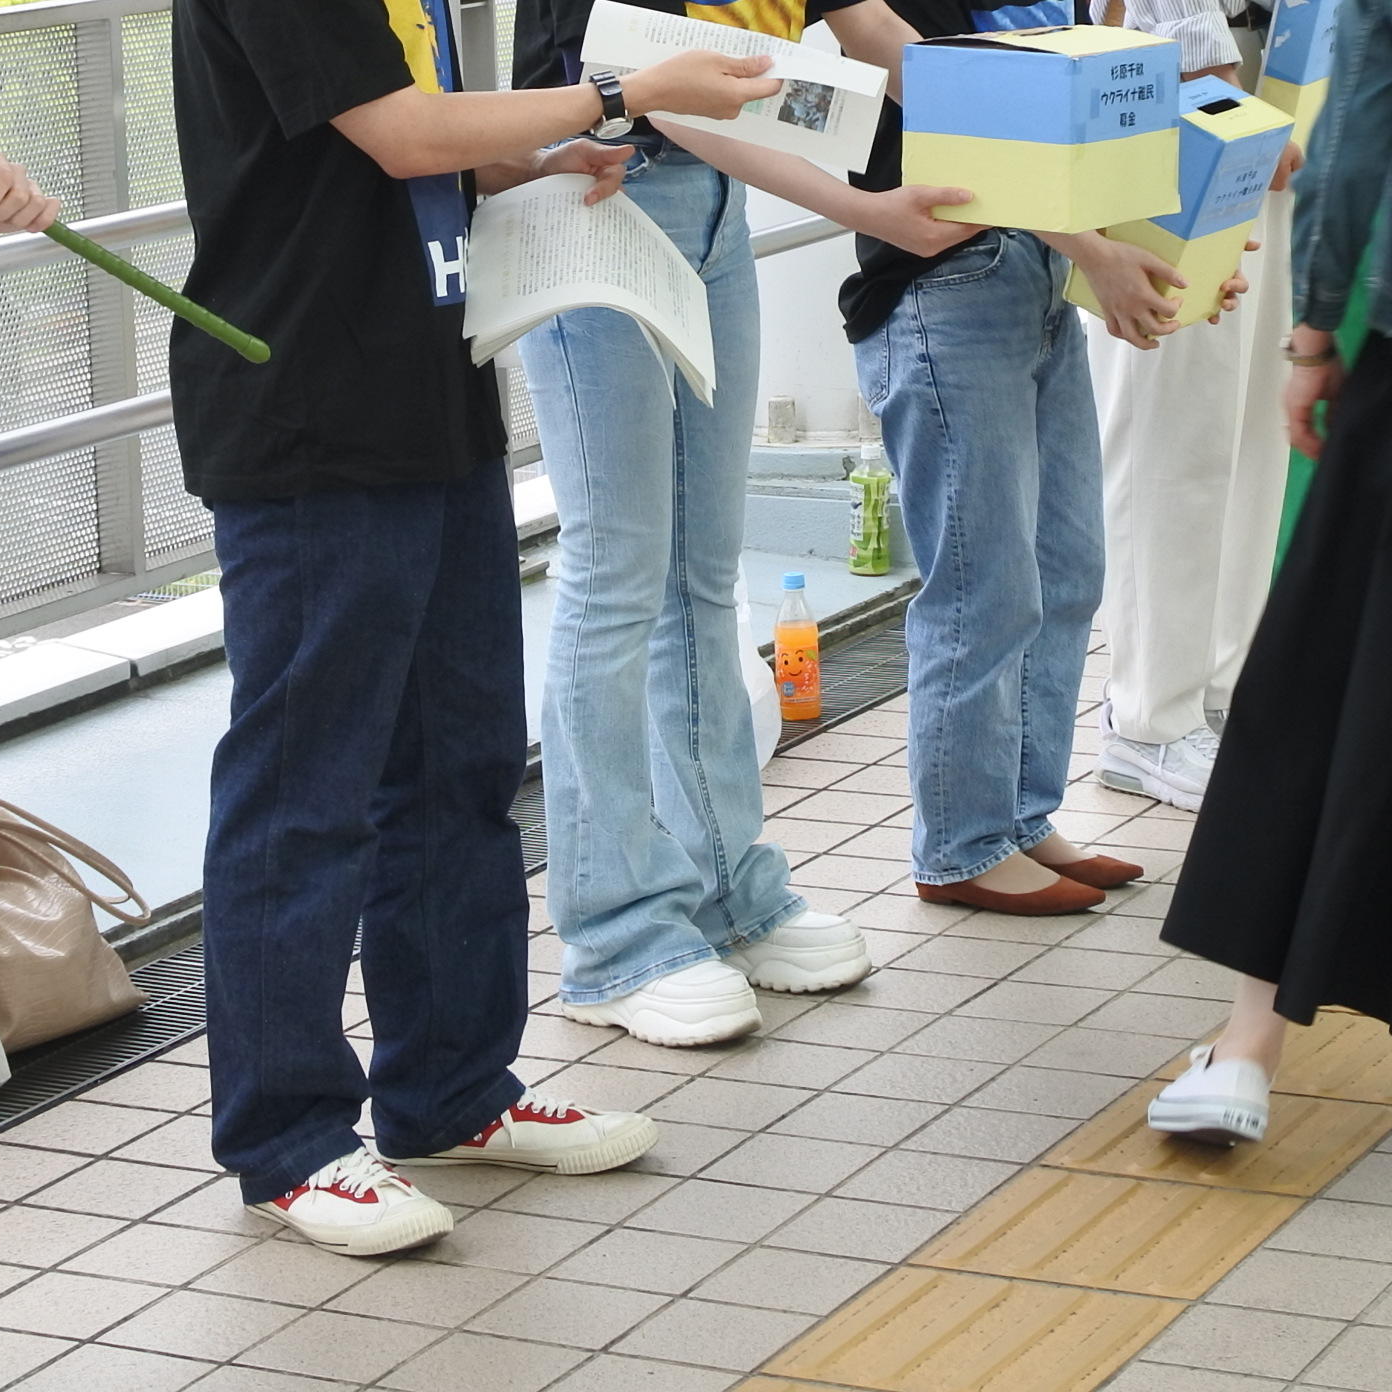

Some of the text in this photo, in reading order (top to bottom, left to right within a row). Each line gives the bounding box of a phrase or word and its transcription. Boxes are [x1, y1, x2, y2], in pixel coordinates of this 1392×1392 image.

[1100, 83, 1155, 107] ウクライナ難民
[427, 228, 469, 298] H
